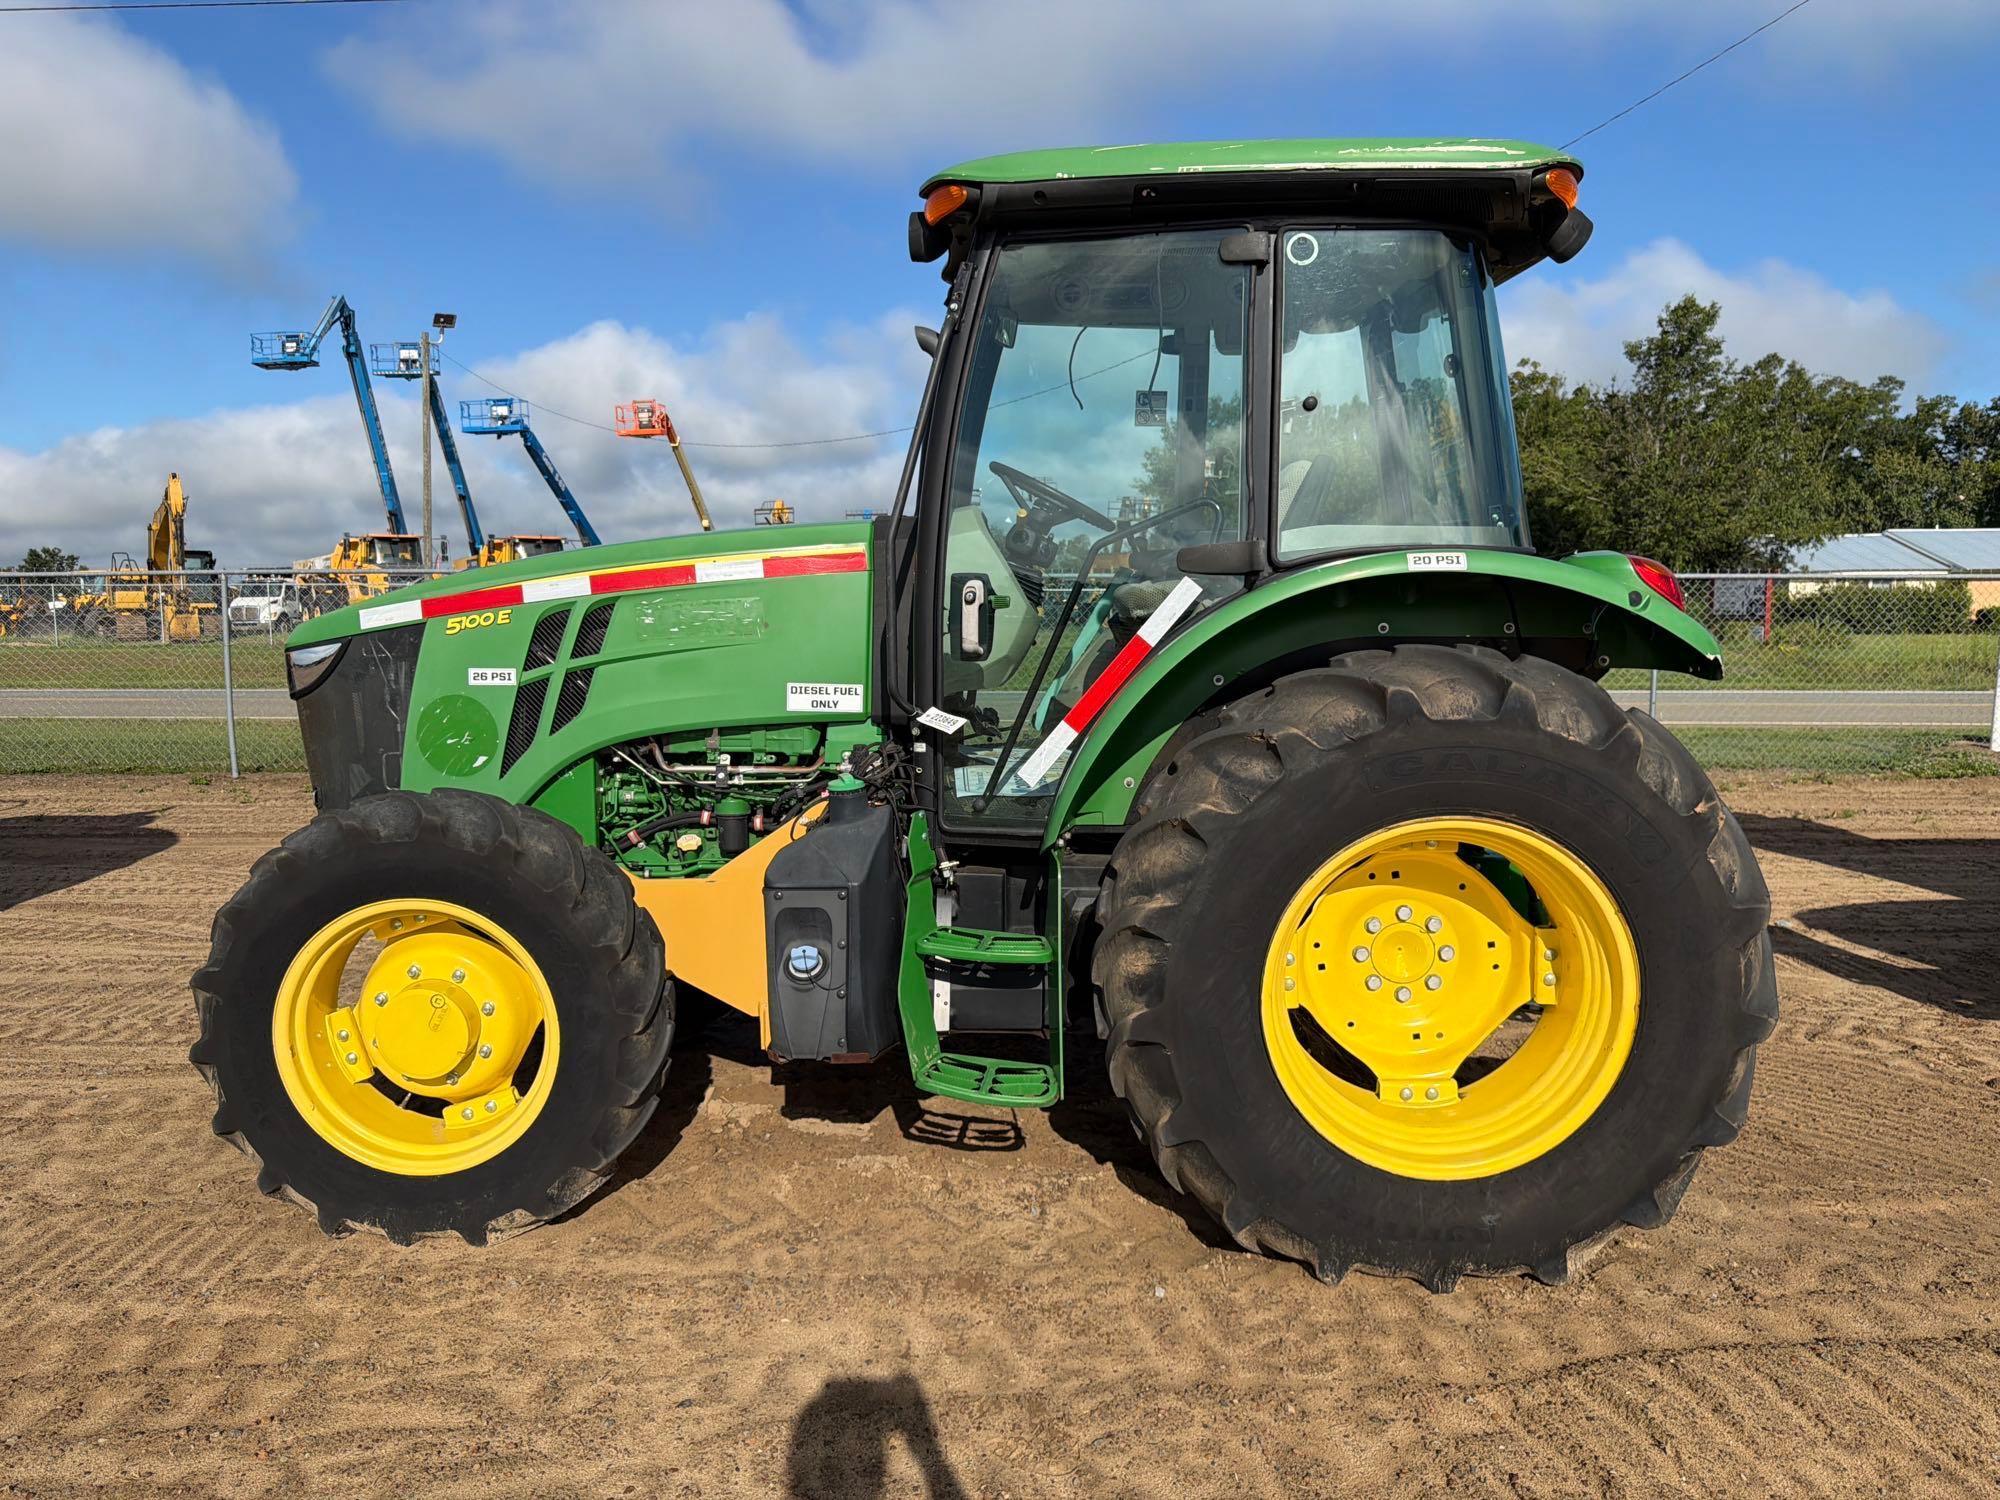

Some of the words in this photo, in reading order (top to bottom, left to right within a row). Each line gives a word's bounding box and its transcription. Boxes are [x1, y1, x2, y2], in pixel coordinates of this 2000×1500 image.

[1413, 555, 1432, 566] 20
[1435, 555, 1462, 566] PSI
[445, 611, 495, 636] 5100
[497, 609, 513, 625] E
[472, 671, 489, 682] 26
[491, 671, 513, 682] PSI
[790, 685, 832, 696] DIESEL
[833, 686, 861, 697] FUEL
[811, 699, 840, 710] ONLY
